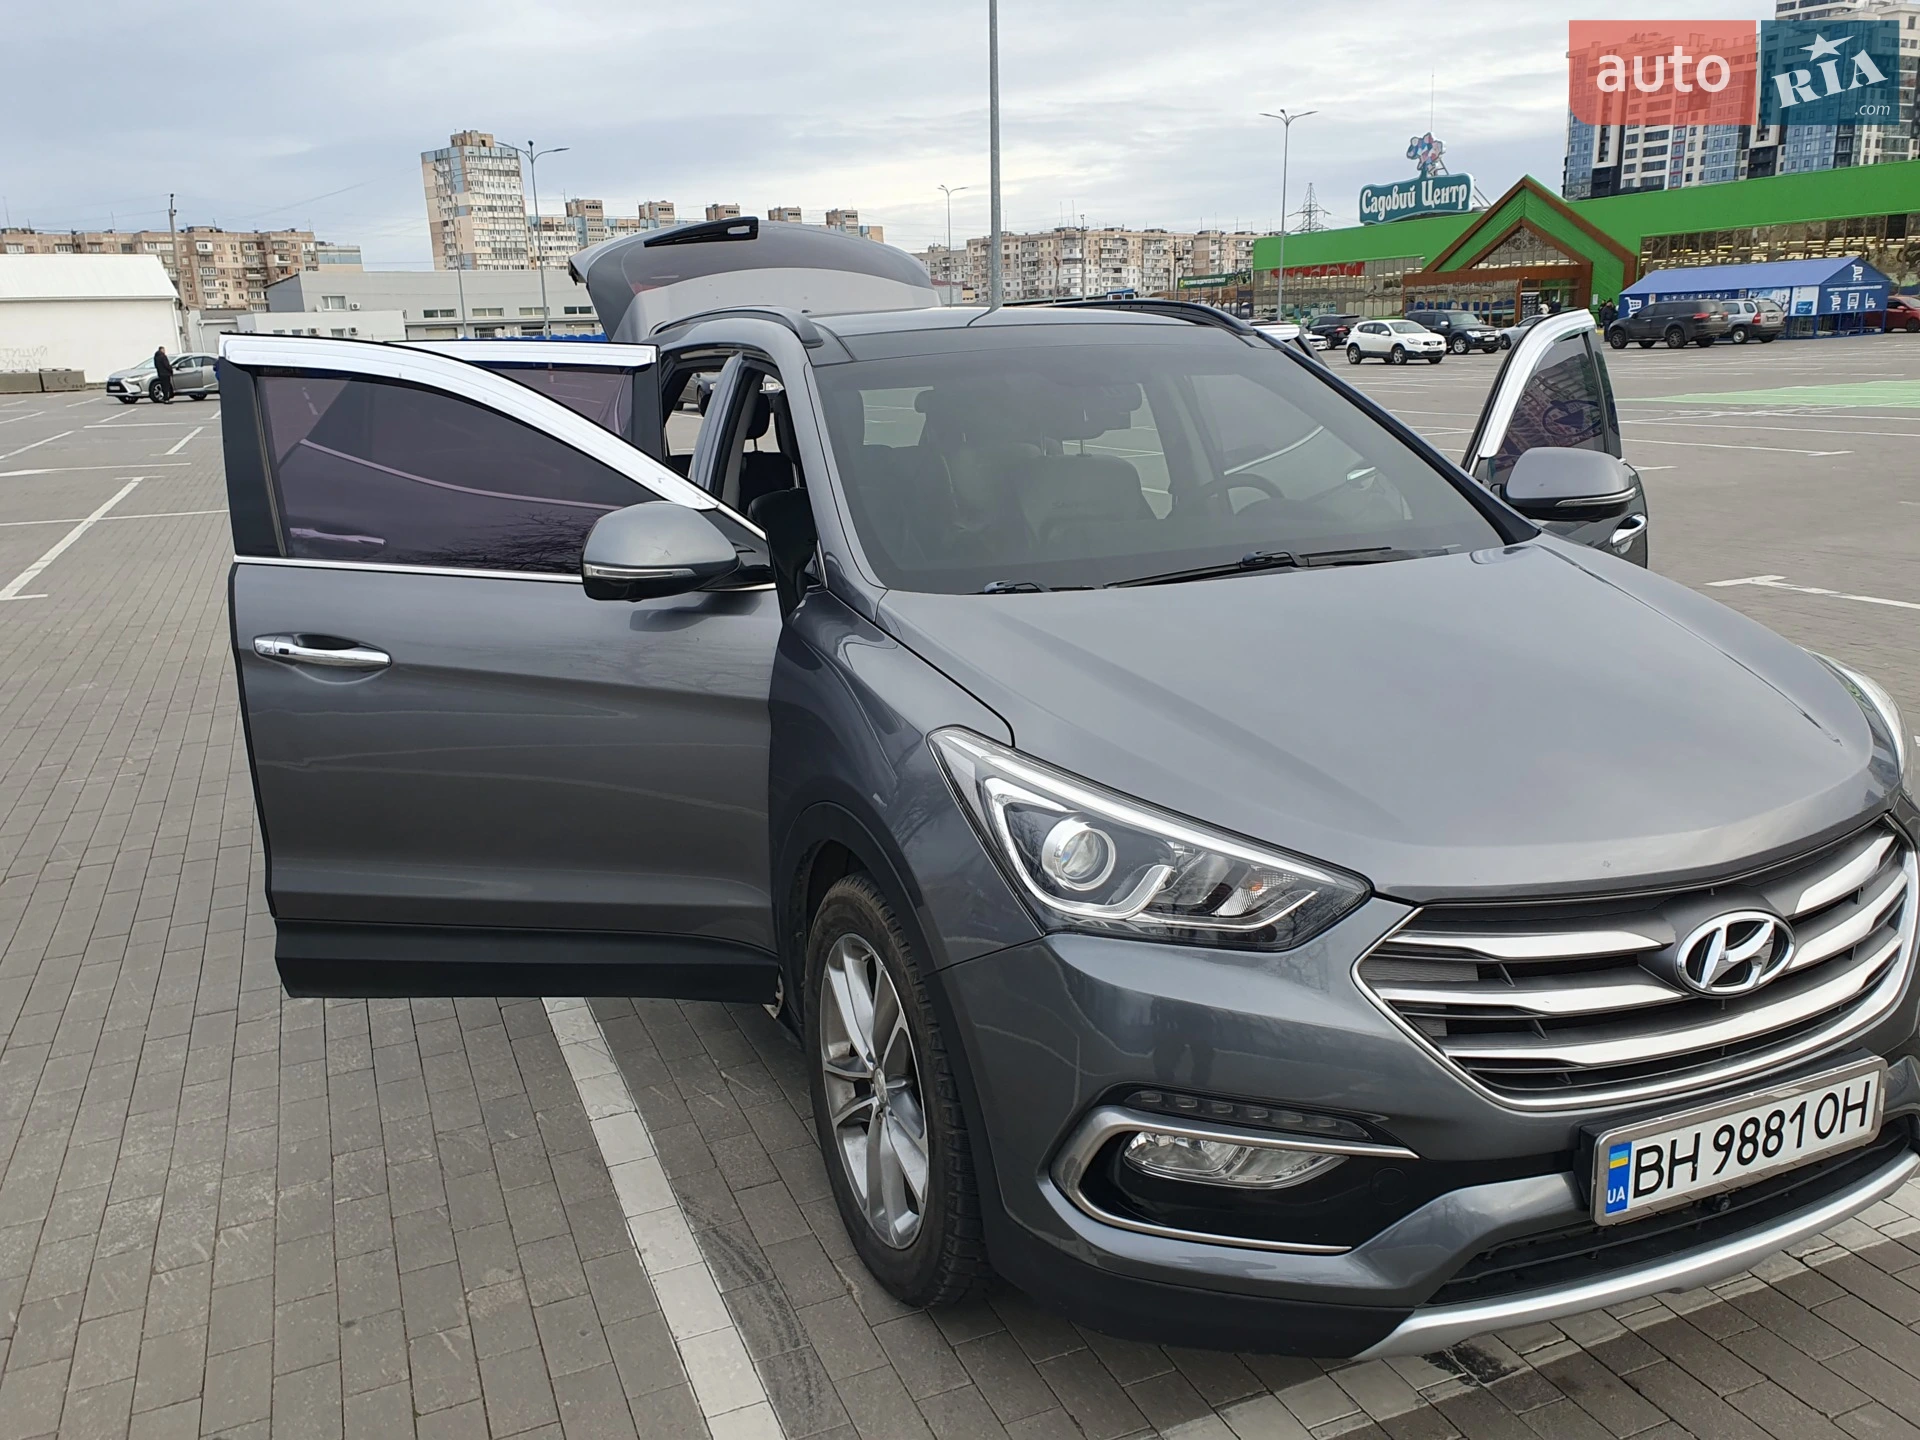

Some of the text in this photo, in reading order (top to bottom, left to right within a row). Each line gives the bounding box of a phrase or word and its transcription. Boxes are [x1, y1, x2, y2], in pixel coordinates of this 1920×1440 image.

[1361, 179, 1468, 221] Садовий Центр
[1633, 1132, 1702, 1199] BH
[1606, 1186, 1626, 1205] UA
